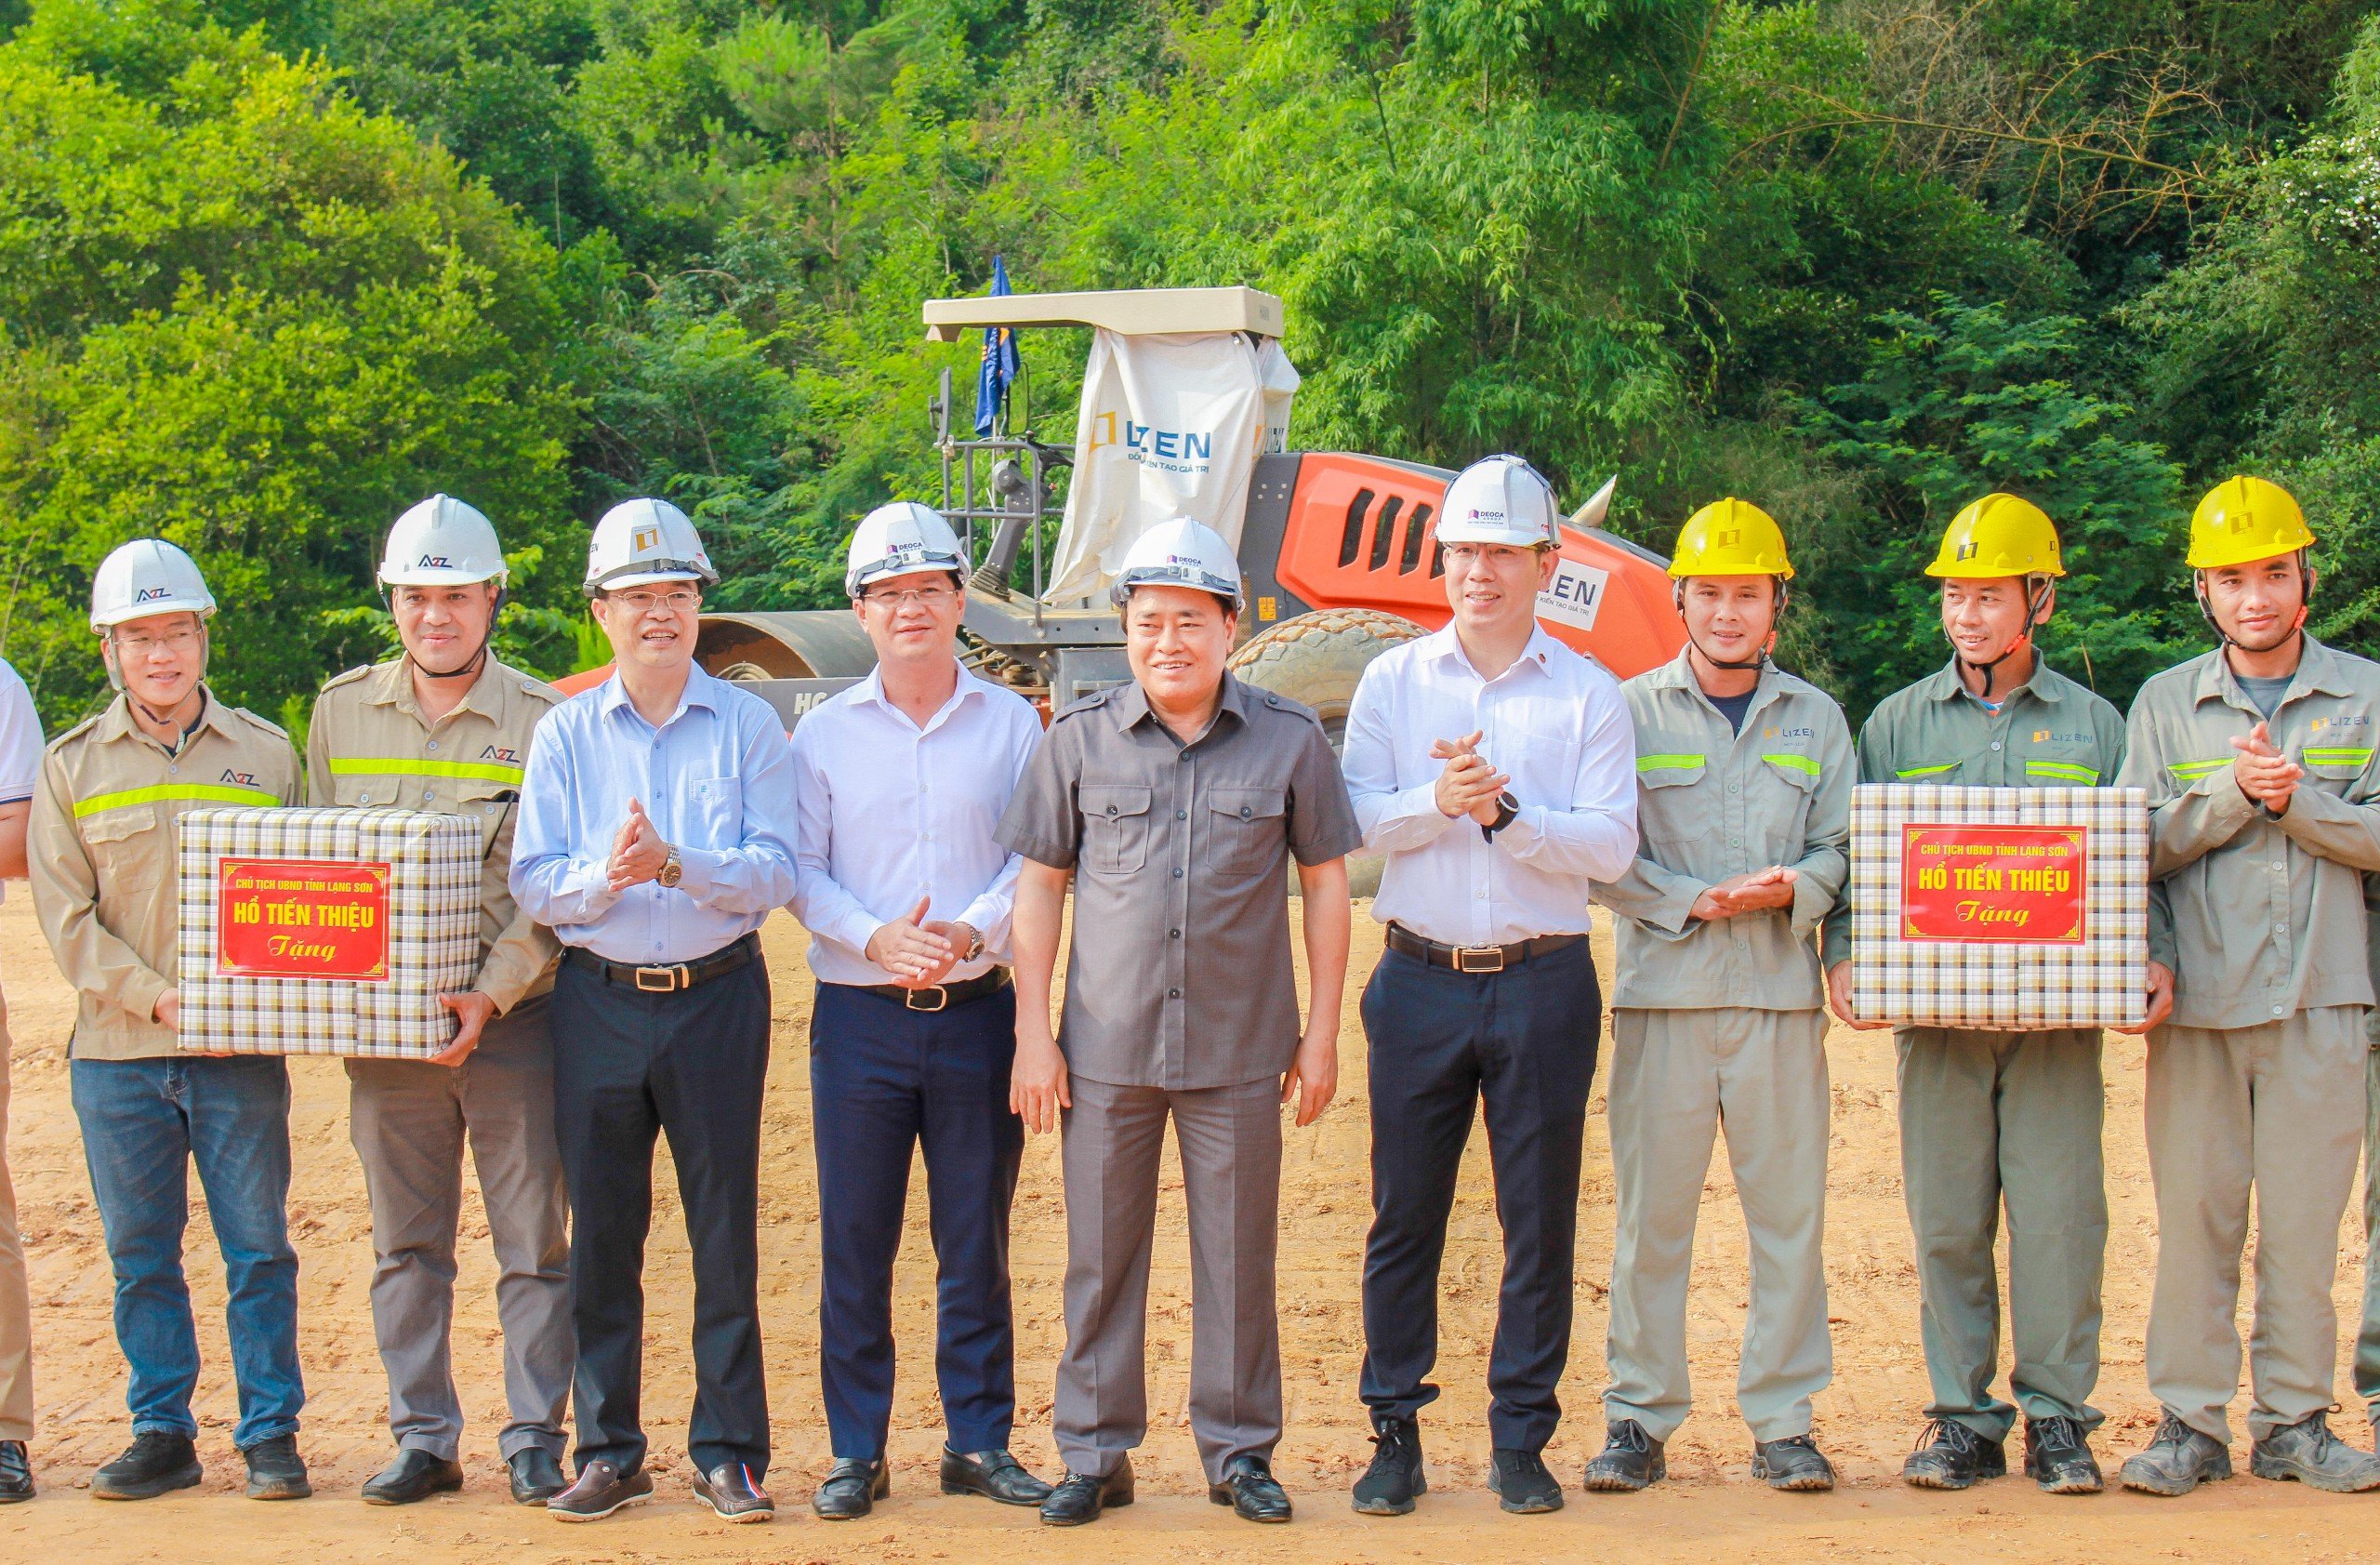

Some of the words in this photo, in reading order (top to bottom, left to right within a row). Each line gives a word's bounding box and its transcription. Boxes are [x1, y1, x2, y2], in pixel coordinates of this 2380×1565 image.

[898, 542, 923, 550] DEOCA
[1178, 556, 1202, 565] DEOCA
[2051, 733, 2093, 744] LIZEN
[1921, 841, 1940, 855] CHỦ
[1943, 843, 1964, 857] TỊCH
[1966, 844, 1993, 856] UBND
[1995, 842, 2017, 856] TỈNH
[2020, 845, 2045, 858] LẠNG
[2048, 845, 2069, 857] SƠN
[234, 877, 254, 890] CHỦ
[256, 880, 276, 893] TỊCH
[278, 881, 302, 891] UBND
[305, 878, 325, 892] TỈNH
[327, 882, 351, 895] LẠNG
[354, 881, 374, 894] SƠN
[1919, 860, 1948, 891] HỒ
[1954, 861, 2002, 891] TIẾN
[2008, 865, 2070, 897] THIỆU
[234, 895, 259, 925] HỒ
[266, 896, 311, 927] TIẾN
[316, 901, 375, 933] THIỆU
[1956, 900, 2030, 928] Tặng
[267, 935, 337, 962] Tặng
